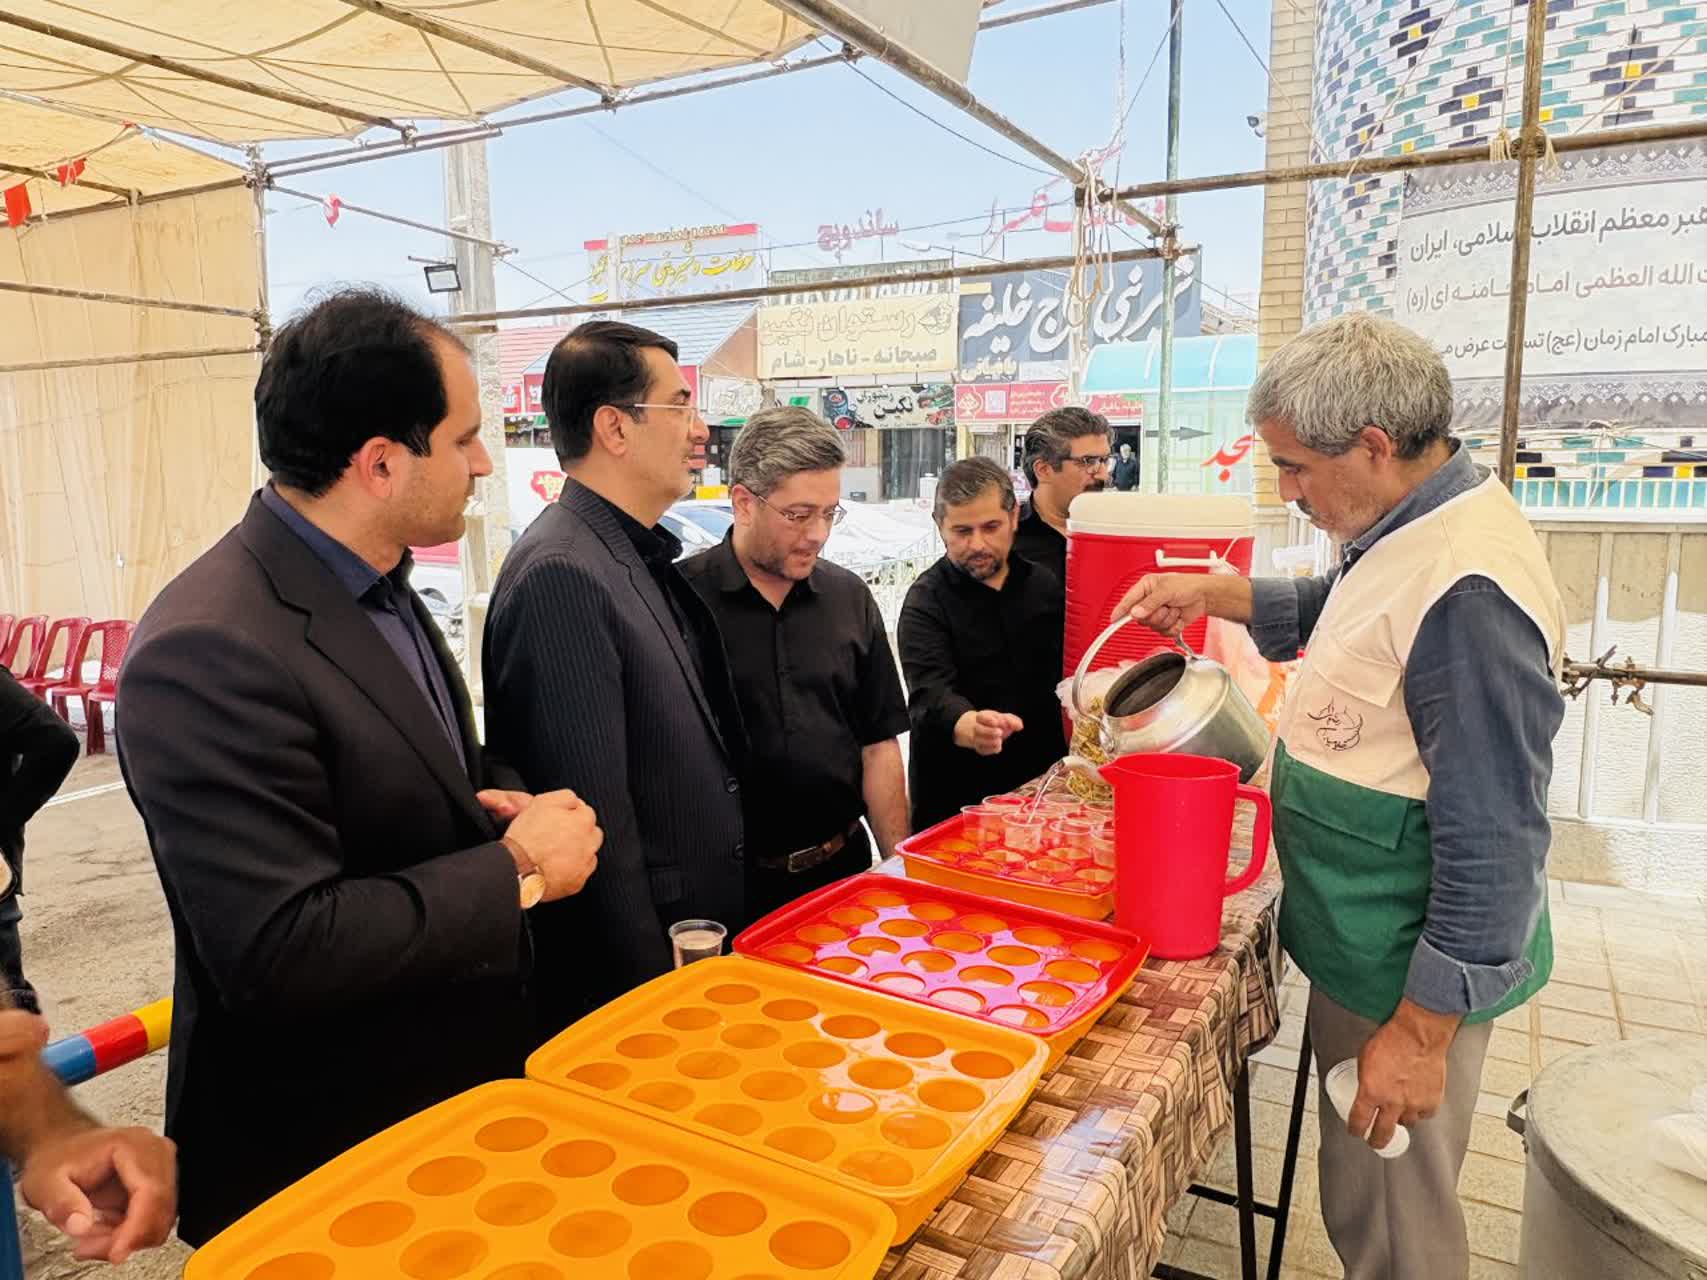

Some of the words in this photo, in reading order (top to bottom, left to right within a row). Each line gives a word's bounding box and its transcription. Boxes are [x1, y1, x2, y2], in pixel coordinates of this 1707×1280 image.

[1452, 221, 1516, 257] سلامی،
[1531, 210, 1597, 246] انقلاب
[1599, 207, 1669, 243] معظم
[1409, 228, 1449, 263] ایران
[1575, 264, 1653, 299] العظمی
[1657, 262, 1695, 286] الله
[1430, 284, 1449, 311] ای
[759, 307, 814, 347] نگین
[816, 304, 916, 343] رستوران
[962, 281, 1034, 354] خلیفه
[1454, 338, 1490, 359] عرض
[1546, 327, 1582, 356] (عج)
[1583, 327, 1623, 352] زمان
[1624, 325, 1661, 353] امام
[873, 395, 914, 420] نگین
